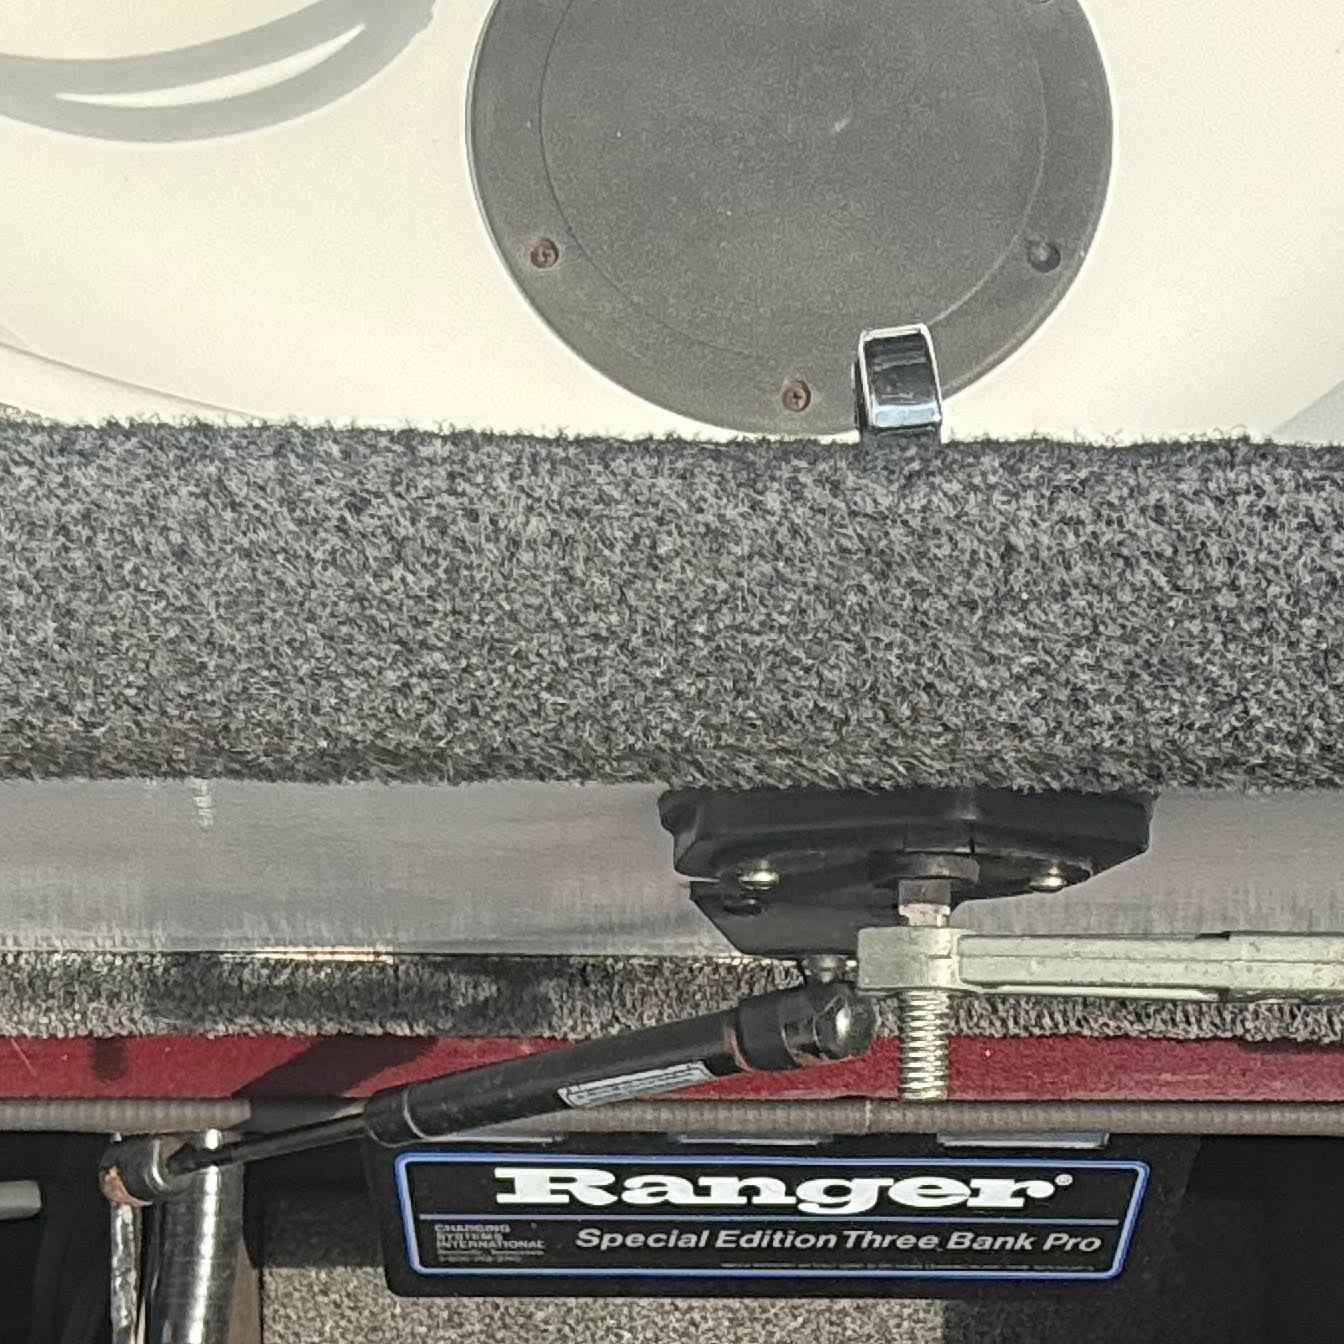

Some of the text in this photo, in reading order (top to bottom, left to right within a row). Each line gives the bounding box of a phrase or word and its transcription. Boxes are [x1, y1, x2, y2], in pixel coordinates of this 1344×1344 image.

[494, 1166, 1055, 1213] Ranger
[575, 1228, 1103, 1252] Special Edition Three Bank Pro
